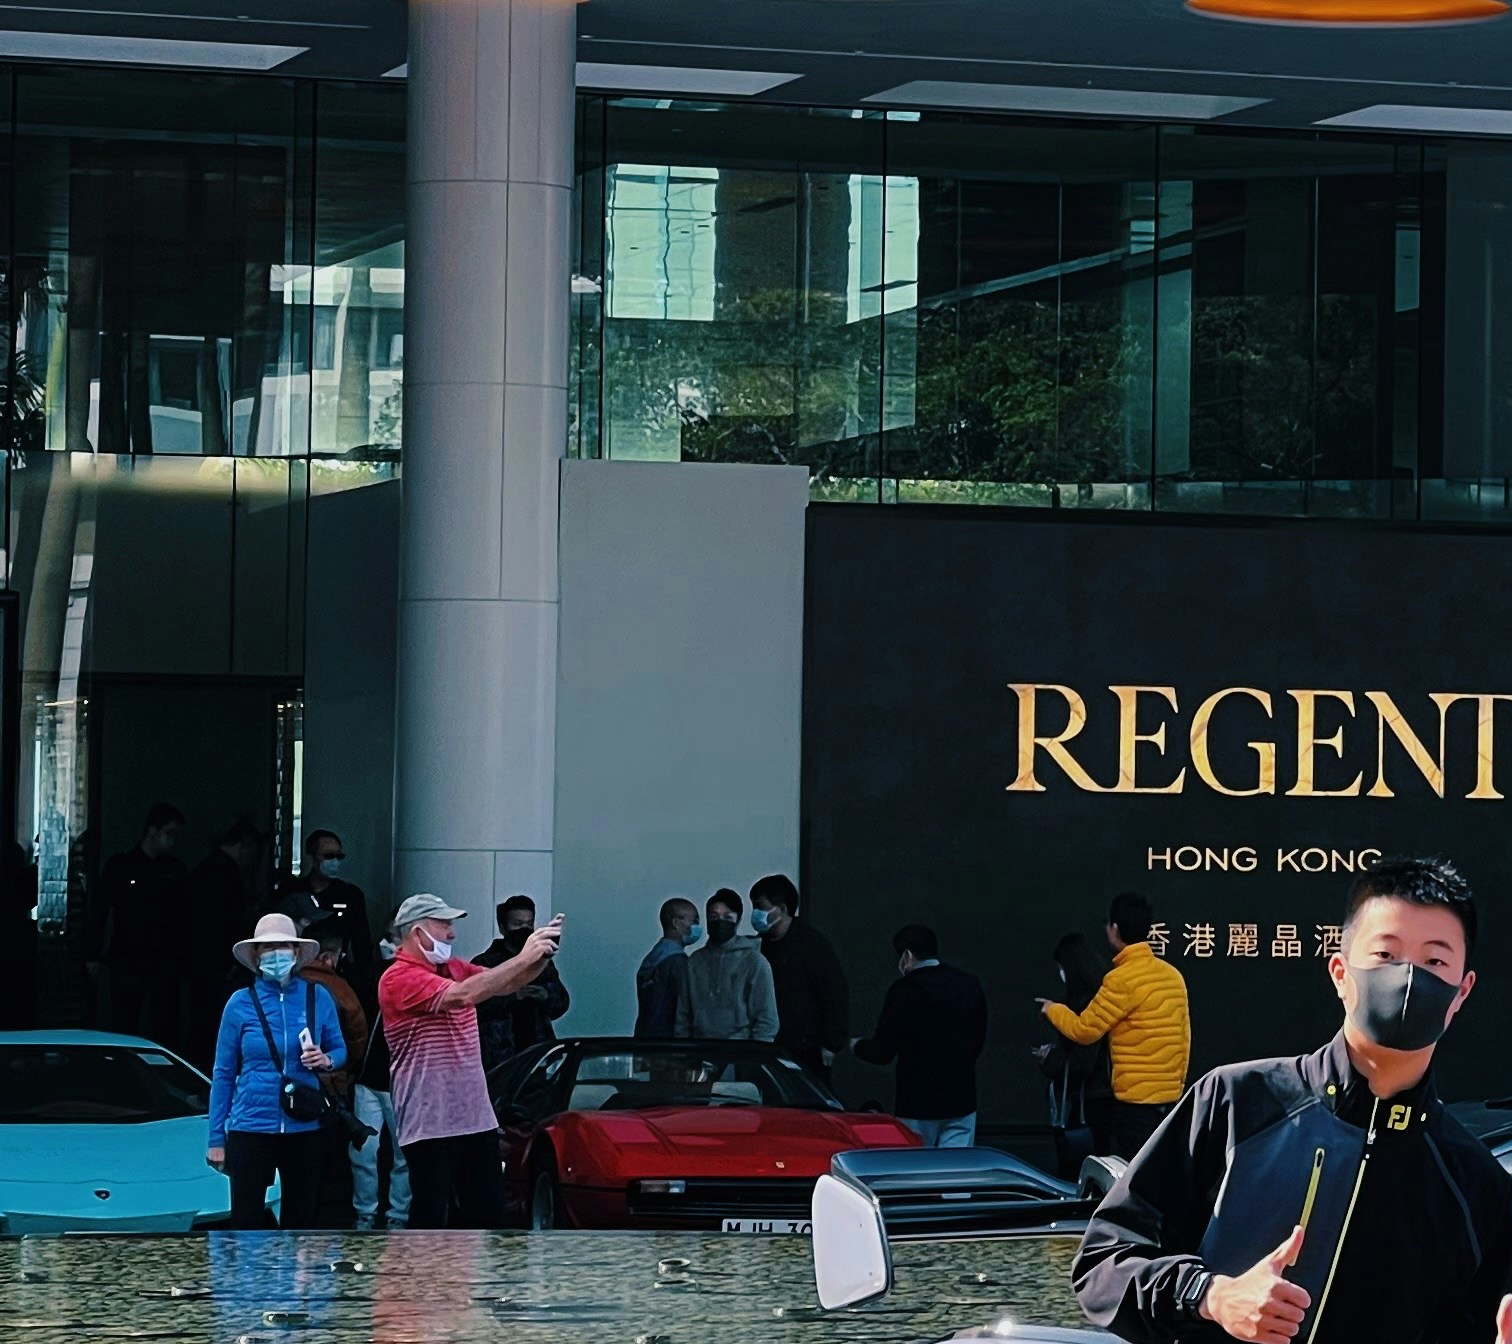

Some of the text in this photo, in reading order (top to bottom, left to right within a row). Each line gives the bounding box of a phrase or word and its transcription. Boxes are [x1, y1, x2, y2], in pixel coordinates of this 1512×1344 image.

[1146, 845, 1383, 874] HONG KONG
[1387, 1105, 1412, 1130] FJ
